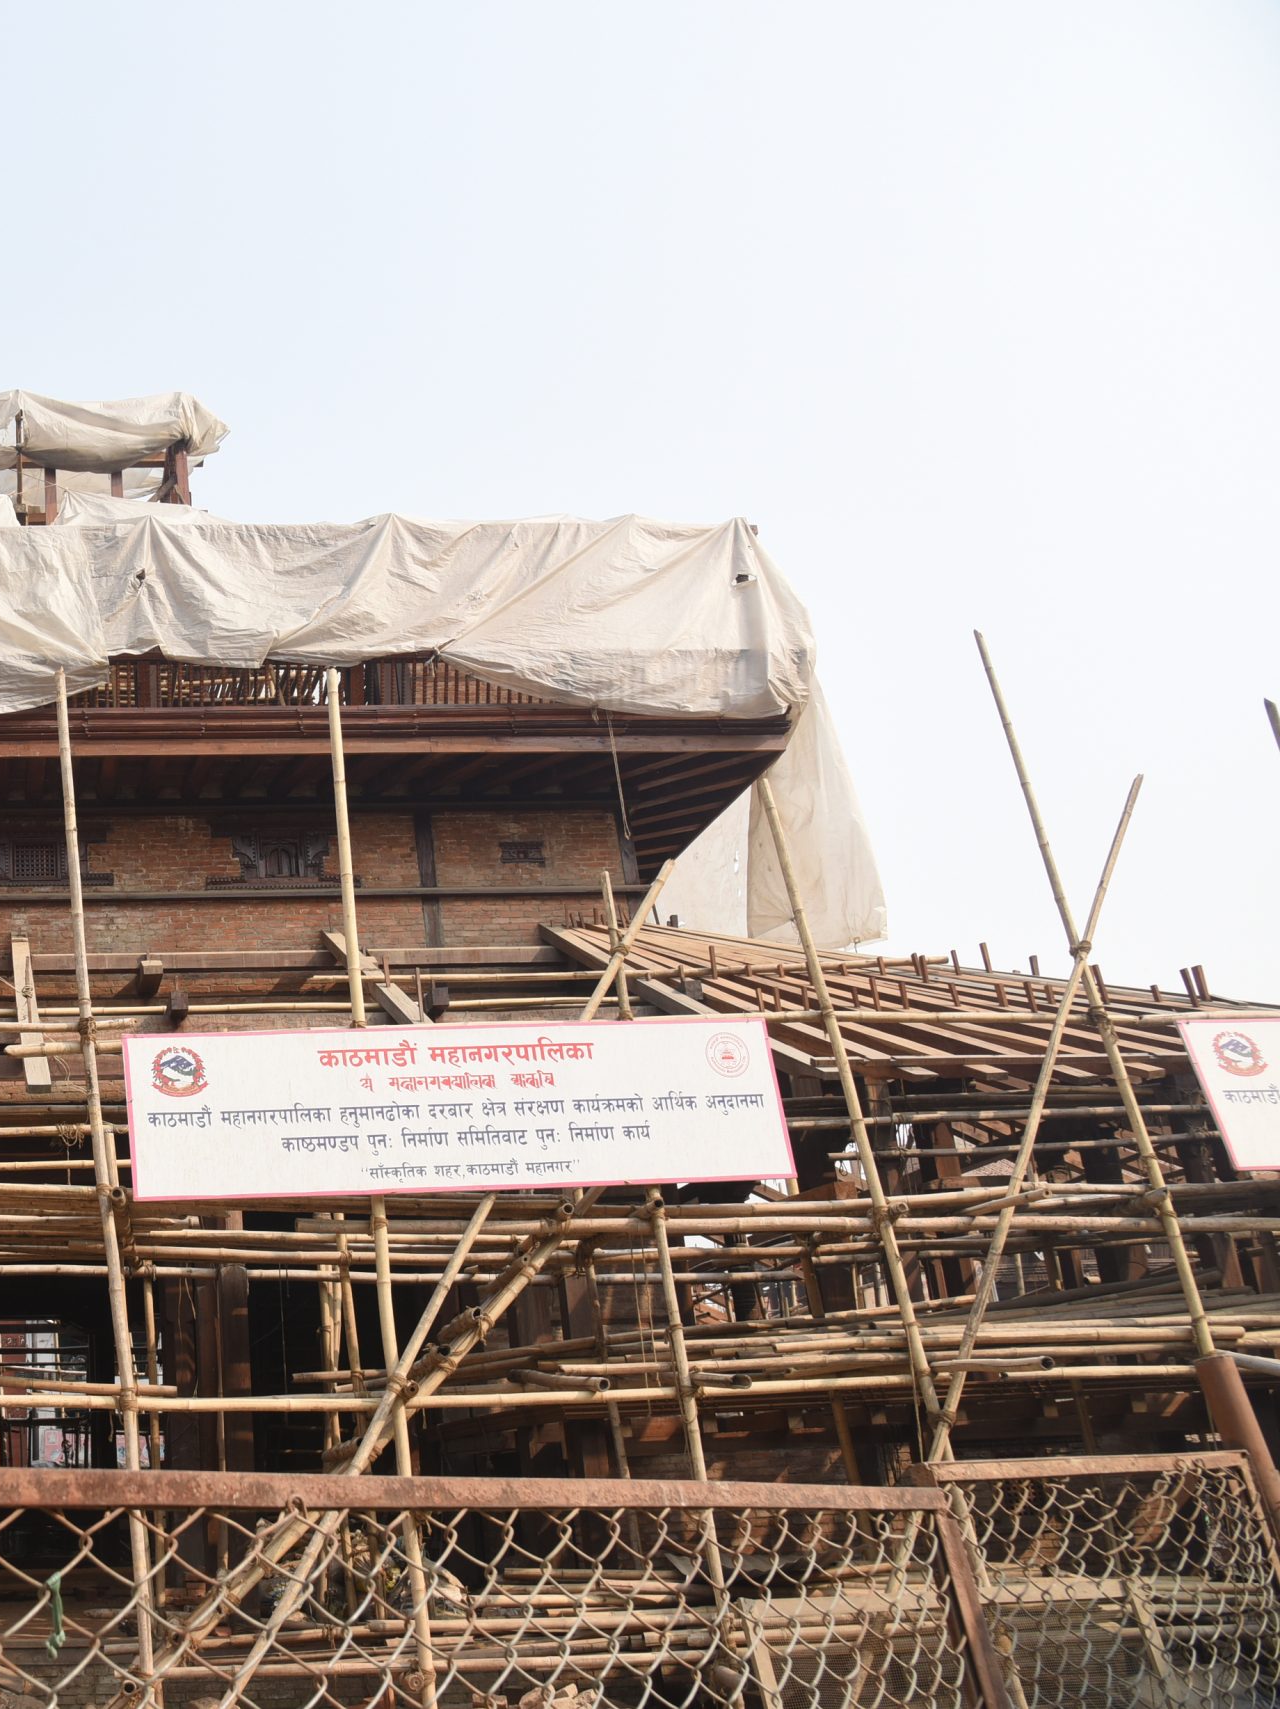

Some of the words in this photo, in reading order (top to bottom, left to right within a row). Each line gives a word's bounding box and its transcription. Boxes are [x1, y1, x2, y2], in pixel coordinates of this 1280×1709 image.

[317, 1039, 418, 1068] काठमाडौं
[428, 1037, 595, 1067] महानगरपालिका
[147, 1104, 212, 1128] काठमाडौं
[220, 1103, 331, 1129] महानगरपालिका
[339, 1100, 420, 1128] हनुमानढोका
[428, 1102, 473, 1120] दरबार
[482, 1097, 507, 1117] क्षेत्र
[513, 1096, 565, 1116] संरक्षण
[572, 1093, 643, 1113] कार्यक्रमको
[652, 1091, 697, 1111] आर्थिक
[705, 1094, 764, 1116] अनुदानमा
[1222, 1083, 1280, 1105] काठमाडौ
[281, 1135, 359, 1153] काष्ठमण्डप
[401, 1127, 448, 1148] निर्माण
[568, 1121, 614, 1143] निर्माण
[622, 1120, 651, 1141] कार्य
